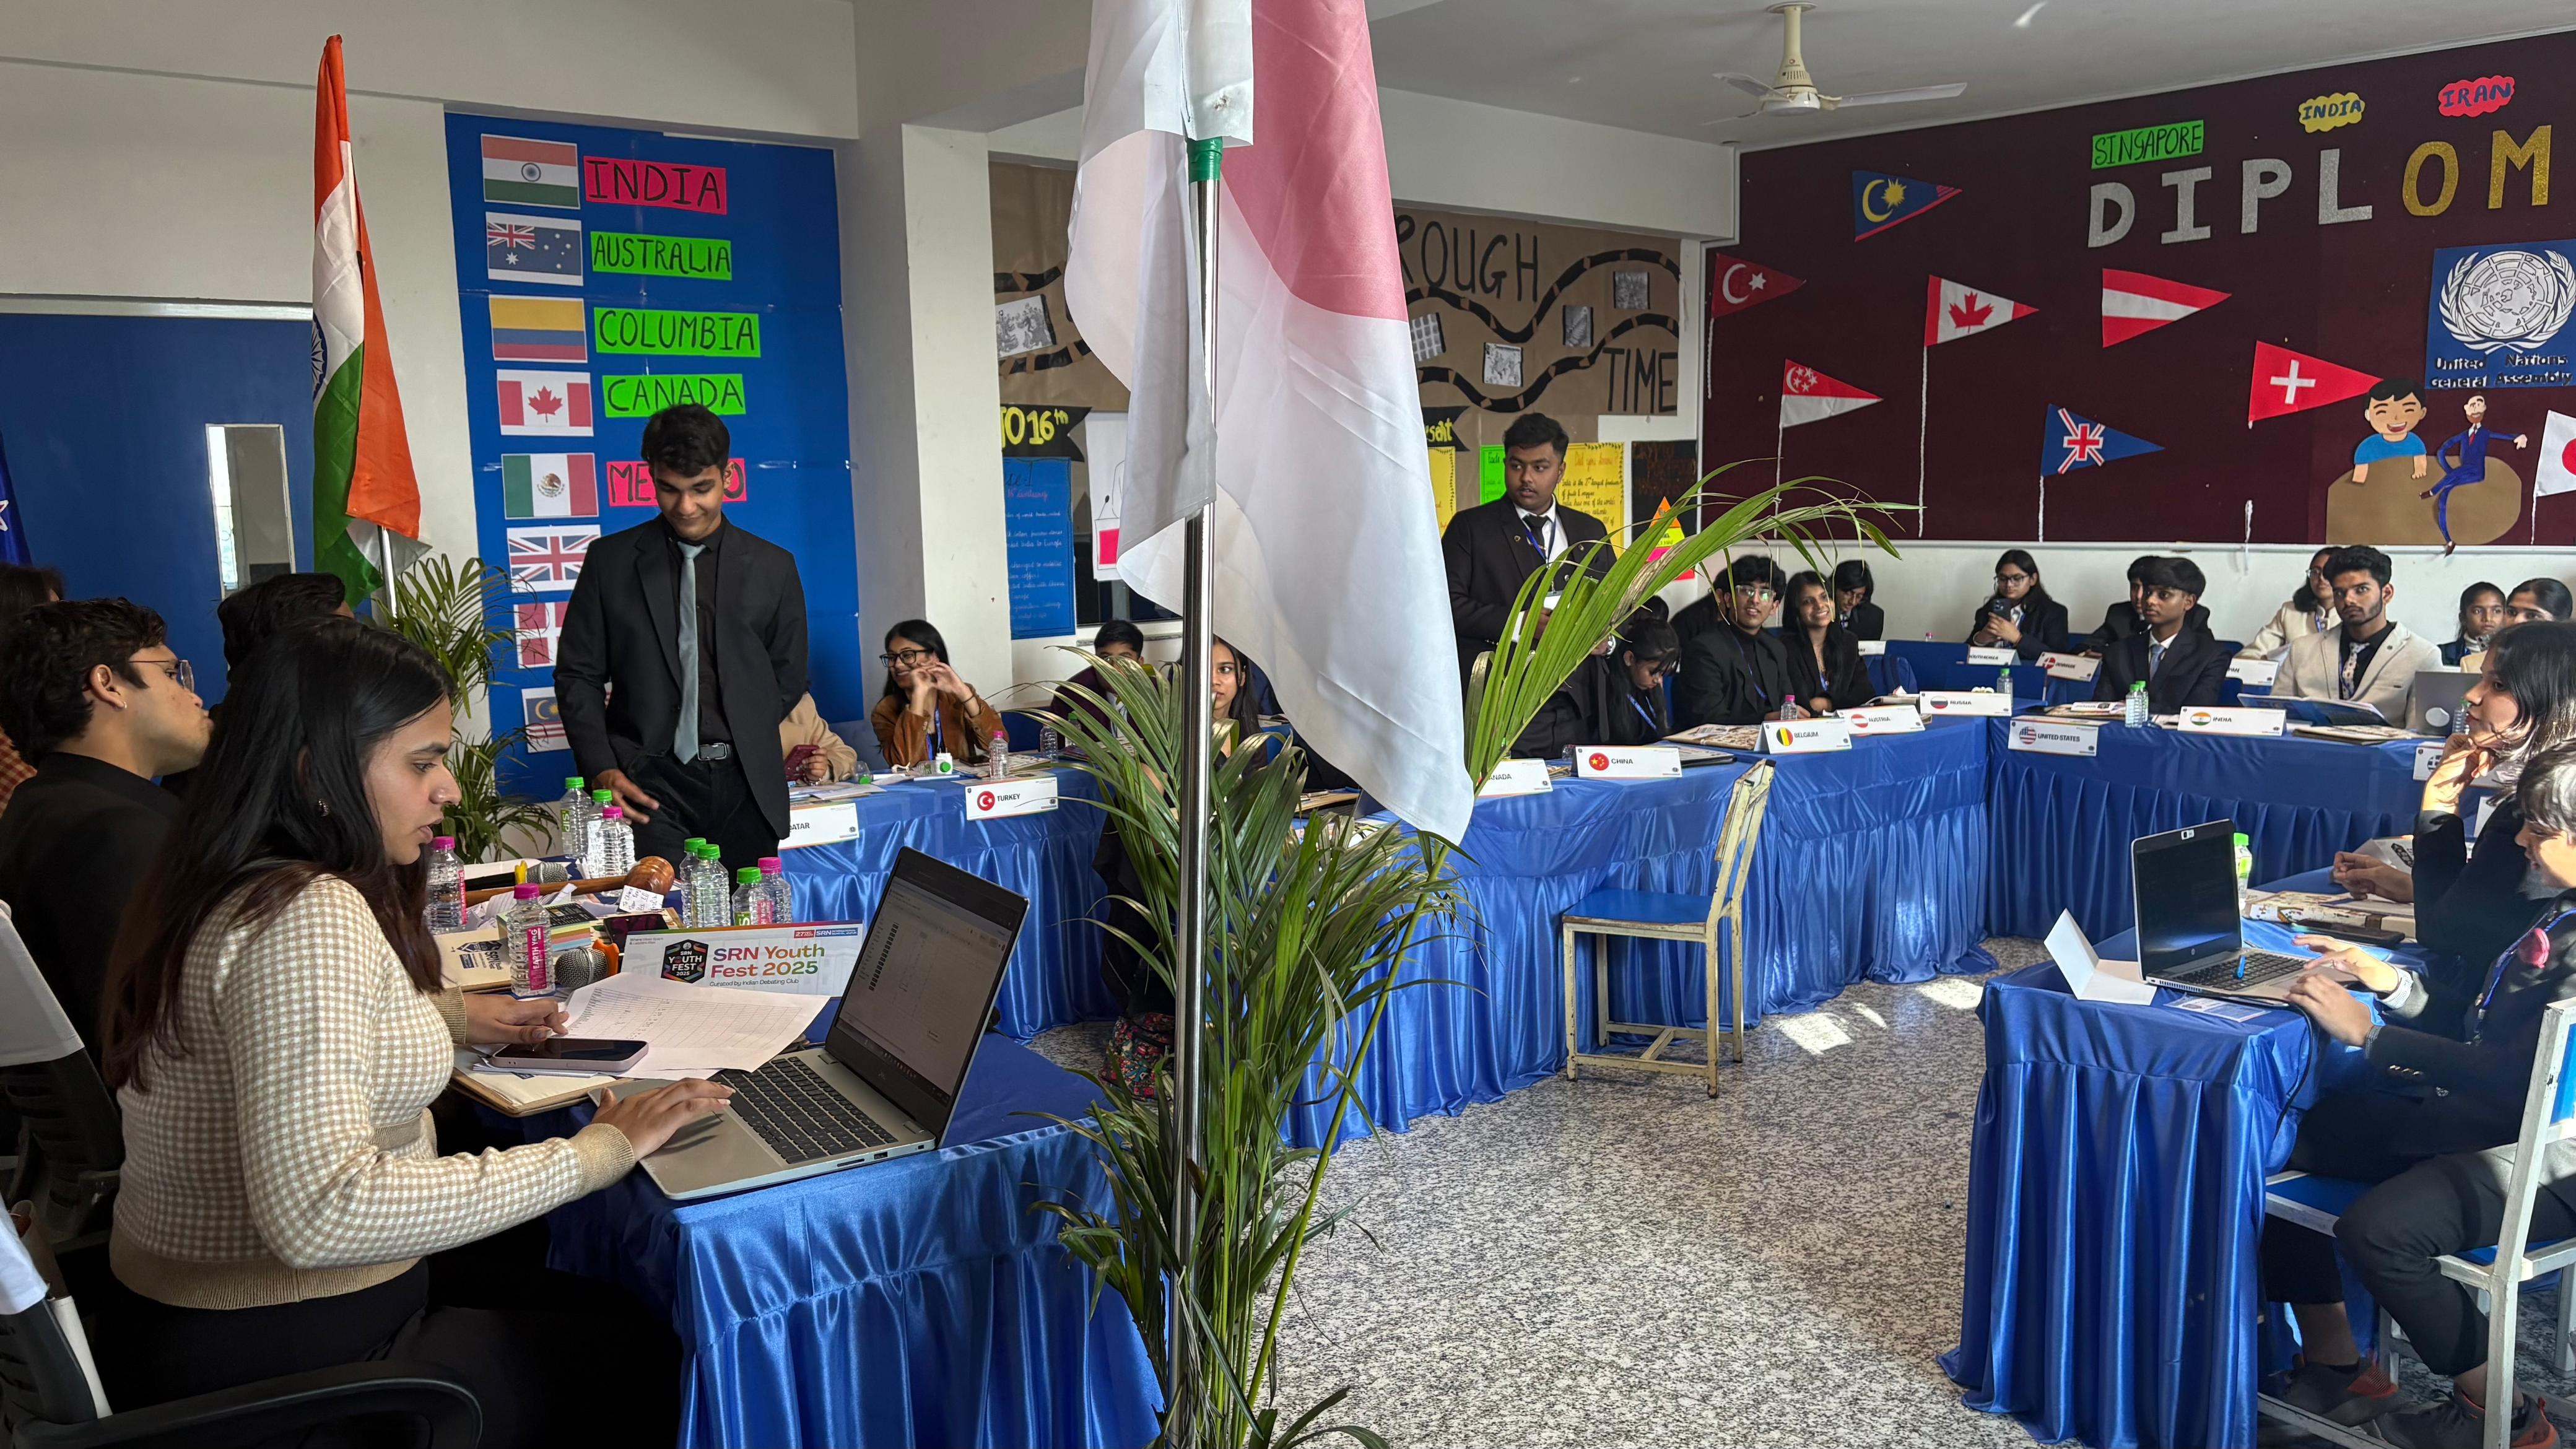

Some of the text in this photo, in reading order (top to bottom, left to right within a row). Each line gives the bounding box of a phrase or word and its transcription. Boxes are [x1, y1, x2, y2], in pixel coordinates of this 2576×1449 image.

[2442, 82, 2512, 108] IRAN
[2302, 99, 2363, 120] INDIA
[2094, 124, 2203, 165] SINGAPORE
[587, 160, 721, 209] INDIA
[2087, 125, 2552, 248] DIPLOM
[593, 235, 731, 274] AUSTRALIA
[1395, 214, 1538, 302] ROUGH
[599, 310, 754, 350] COLUMBIA
[2435, 354, 2568, 370] United Nations
[1603, 347, 1678, 413] TIME
[2495, 372, 2573, 387] Assembly
[606, 378, 743, 411] CANADA
[1027, 408, 1069, 445] 16th
[1425, 418, 1453, 442] sent
[610, 464, 744, 502] MEO
[2038, 733, 2058, 741] UNITED
[997, 793, 1020, 802] TURKEY
[562, 813, 570, 832] SIP
[532, 947, 540, 969] EARTH
[713, 944, 825, 962] SRN Youth
[672, 963, 697, 971] FEST
[711, 960, 819, 978] Fest 2025
